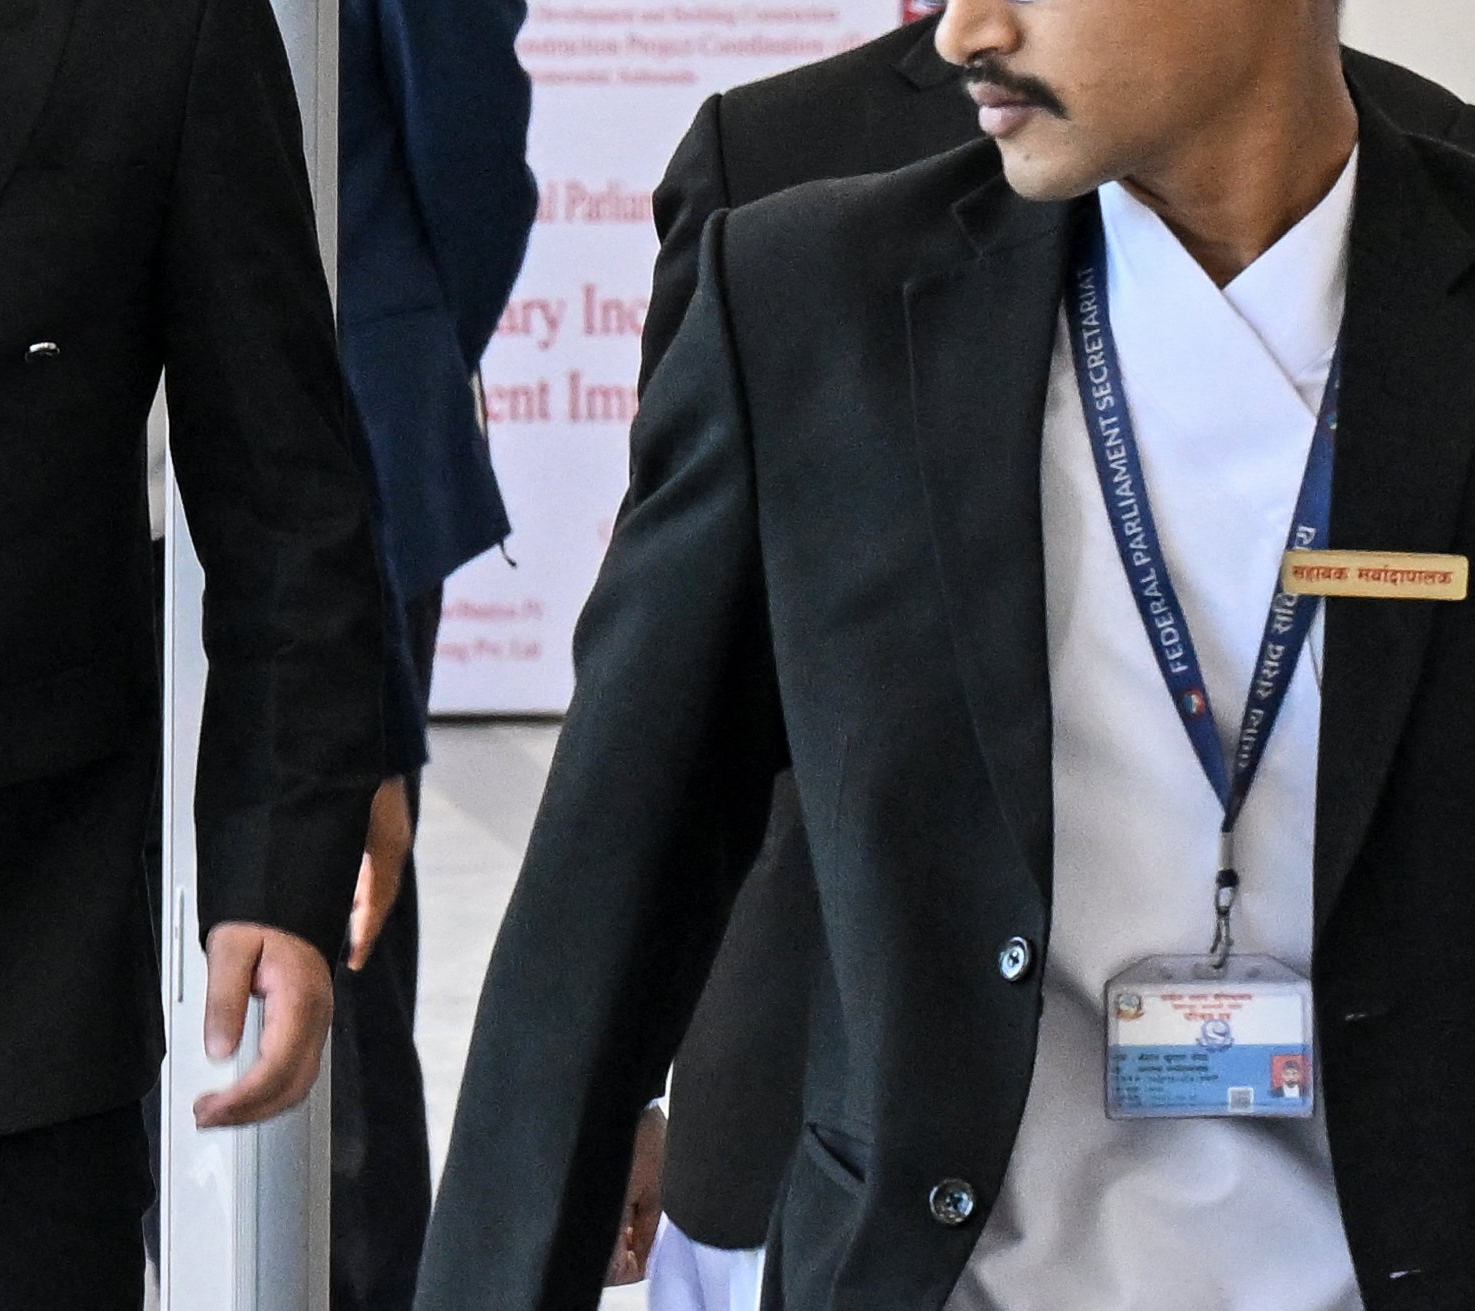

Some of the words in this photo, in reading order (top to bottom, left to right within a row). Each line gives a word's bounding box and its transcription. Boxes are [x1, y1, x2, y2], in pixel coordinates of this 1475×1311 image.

[1078, 267, 1115, 411] SECRETARIAT
[1100, 416, 1152, 568] PARLIAMENT
[1140, 567, 1189, 674] FEDERAL
